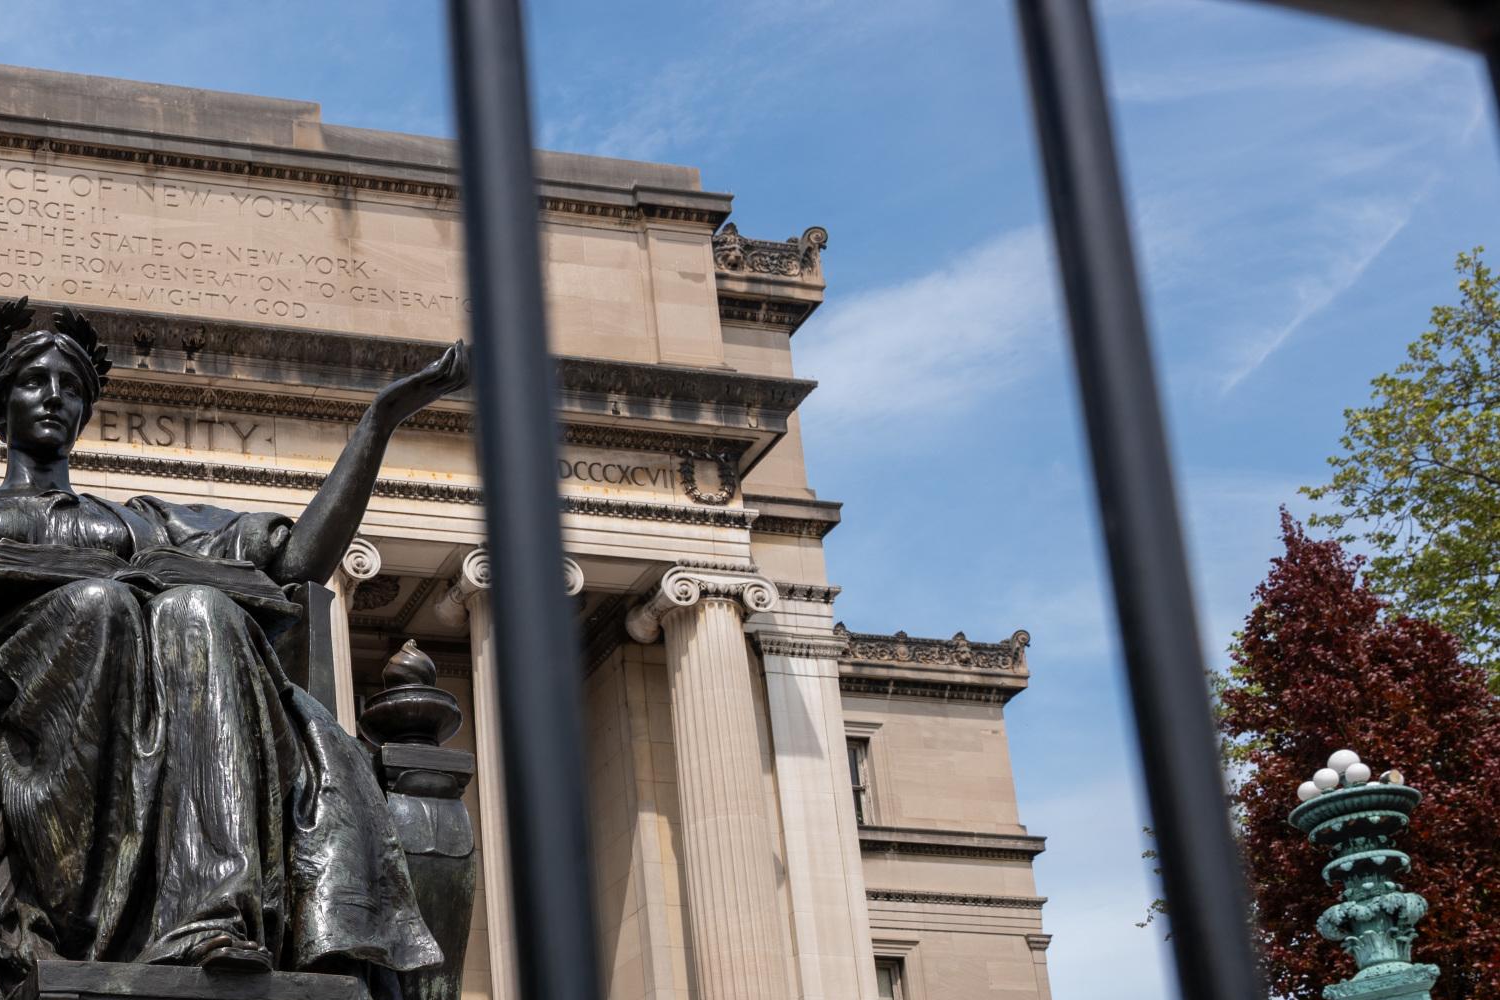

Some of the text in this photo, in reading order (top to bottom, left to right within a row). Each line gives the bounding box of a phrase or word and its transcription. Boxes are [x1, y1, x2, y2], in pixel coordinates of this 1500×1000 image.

[68, 174, 113, 200] OF
[135, 180, 212, 209] NEW
[230, 192, 324, 224] YORK
[21, 223, 76, 247] THE
[89, 231, 164, 256] STATE
[177, 241, 213, 260] OF
[226, 246, 283, 267] NEW
[298, 254, 371, 280] YORK
[60, 254, 124, 275] FROM
[141, 263, 291, 292] GENERATION
[304, 280, 336, 298] TO
[61, 278, 93, 295] OF
[107, 283, 238, 308] ALMIGHTY
[253, 297, 309, 319] GOD
